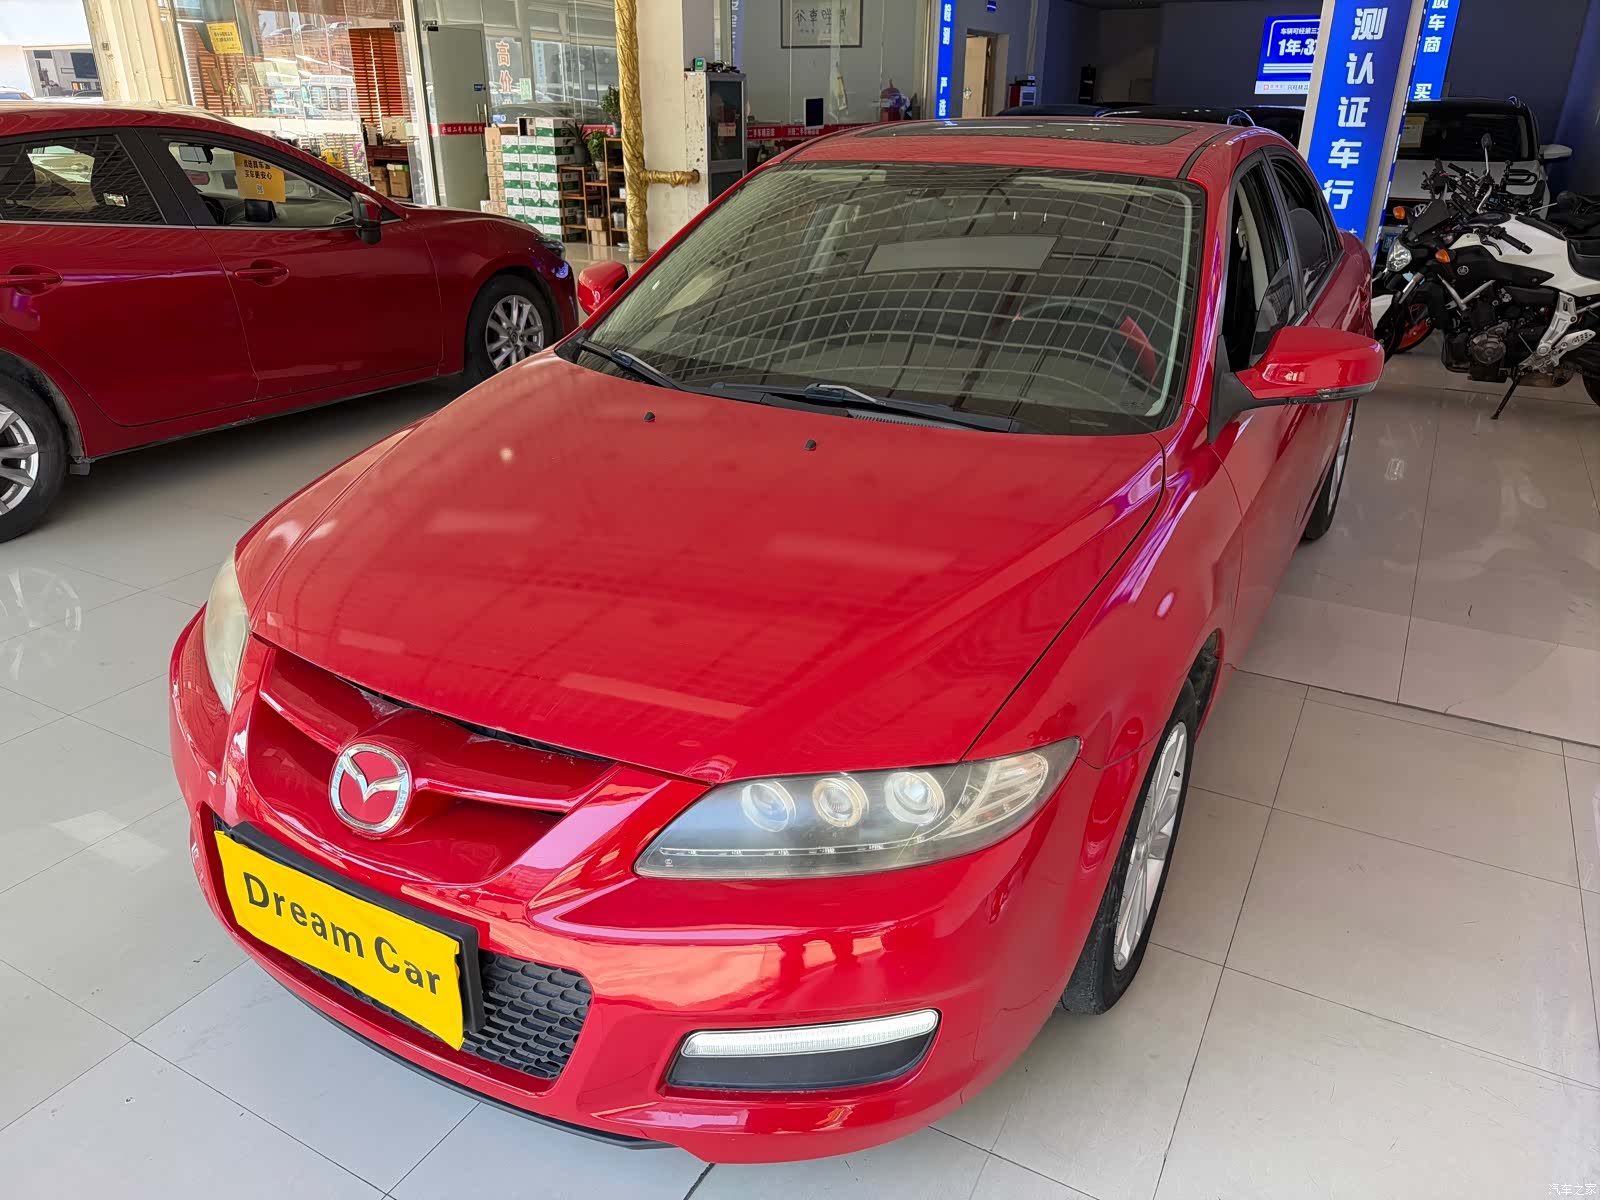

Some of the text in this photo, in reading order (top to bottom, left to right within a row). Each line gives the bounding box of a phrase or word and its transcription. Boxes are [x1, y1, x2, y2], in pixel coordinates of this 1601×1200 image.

[1278, 38, 1318, 56] 1年/3
[1280, 27, 1320, 35] 车辆可经第三
[1322, 7, 1388, 210] 测认证车行
[243, 871, 441, 995] Dream Car
